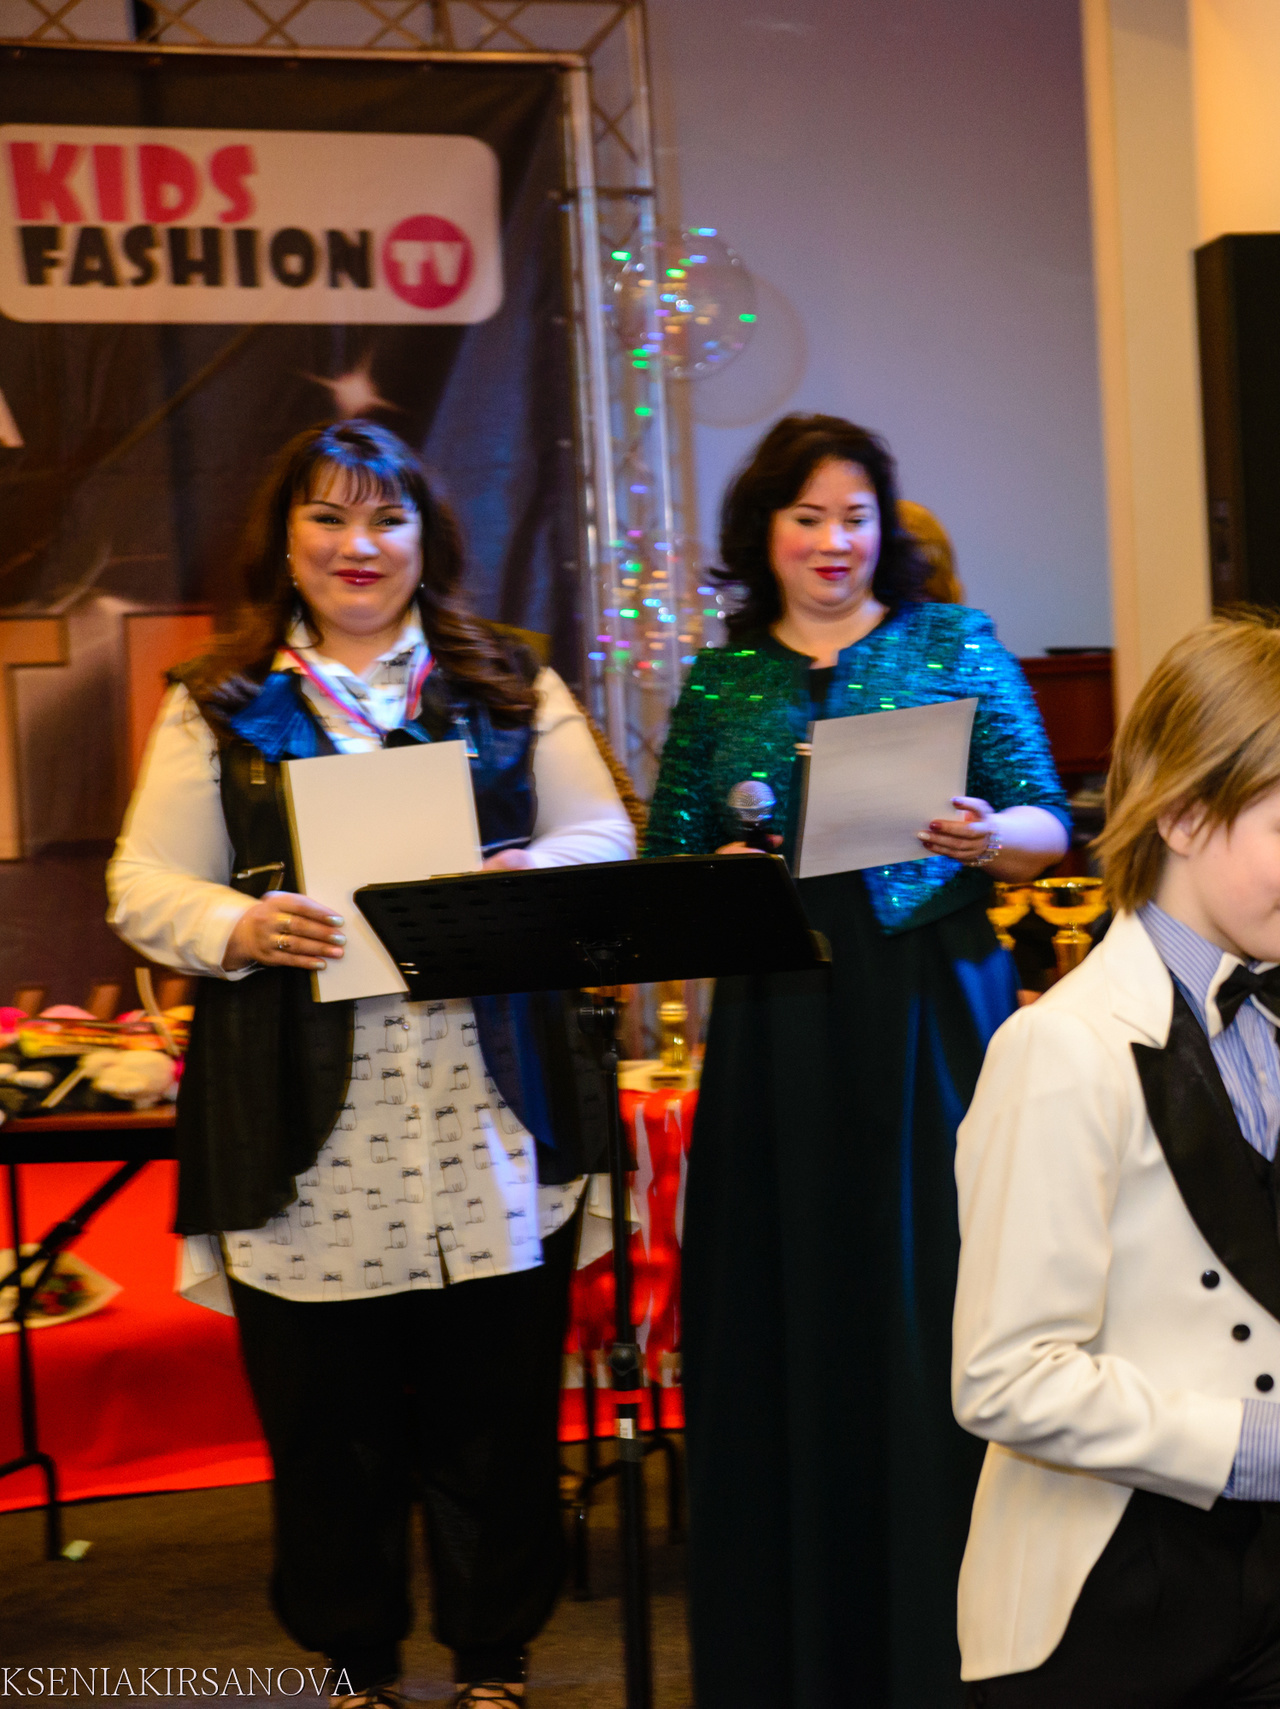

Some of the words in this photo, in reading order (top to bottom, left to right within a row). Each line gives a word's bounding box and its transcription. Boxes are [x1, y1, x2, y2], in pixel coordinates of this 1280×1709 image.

[7, 141, 259, 224] KIDS
[15, 224, 374, 289] FASHION
[390, 240, 464, 287] TV
